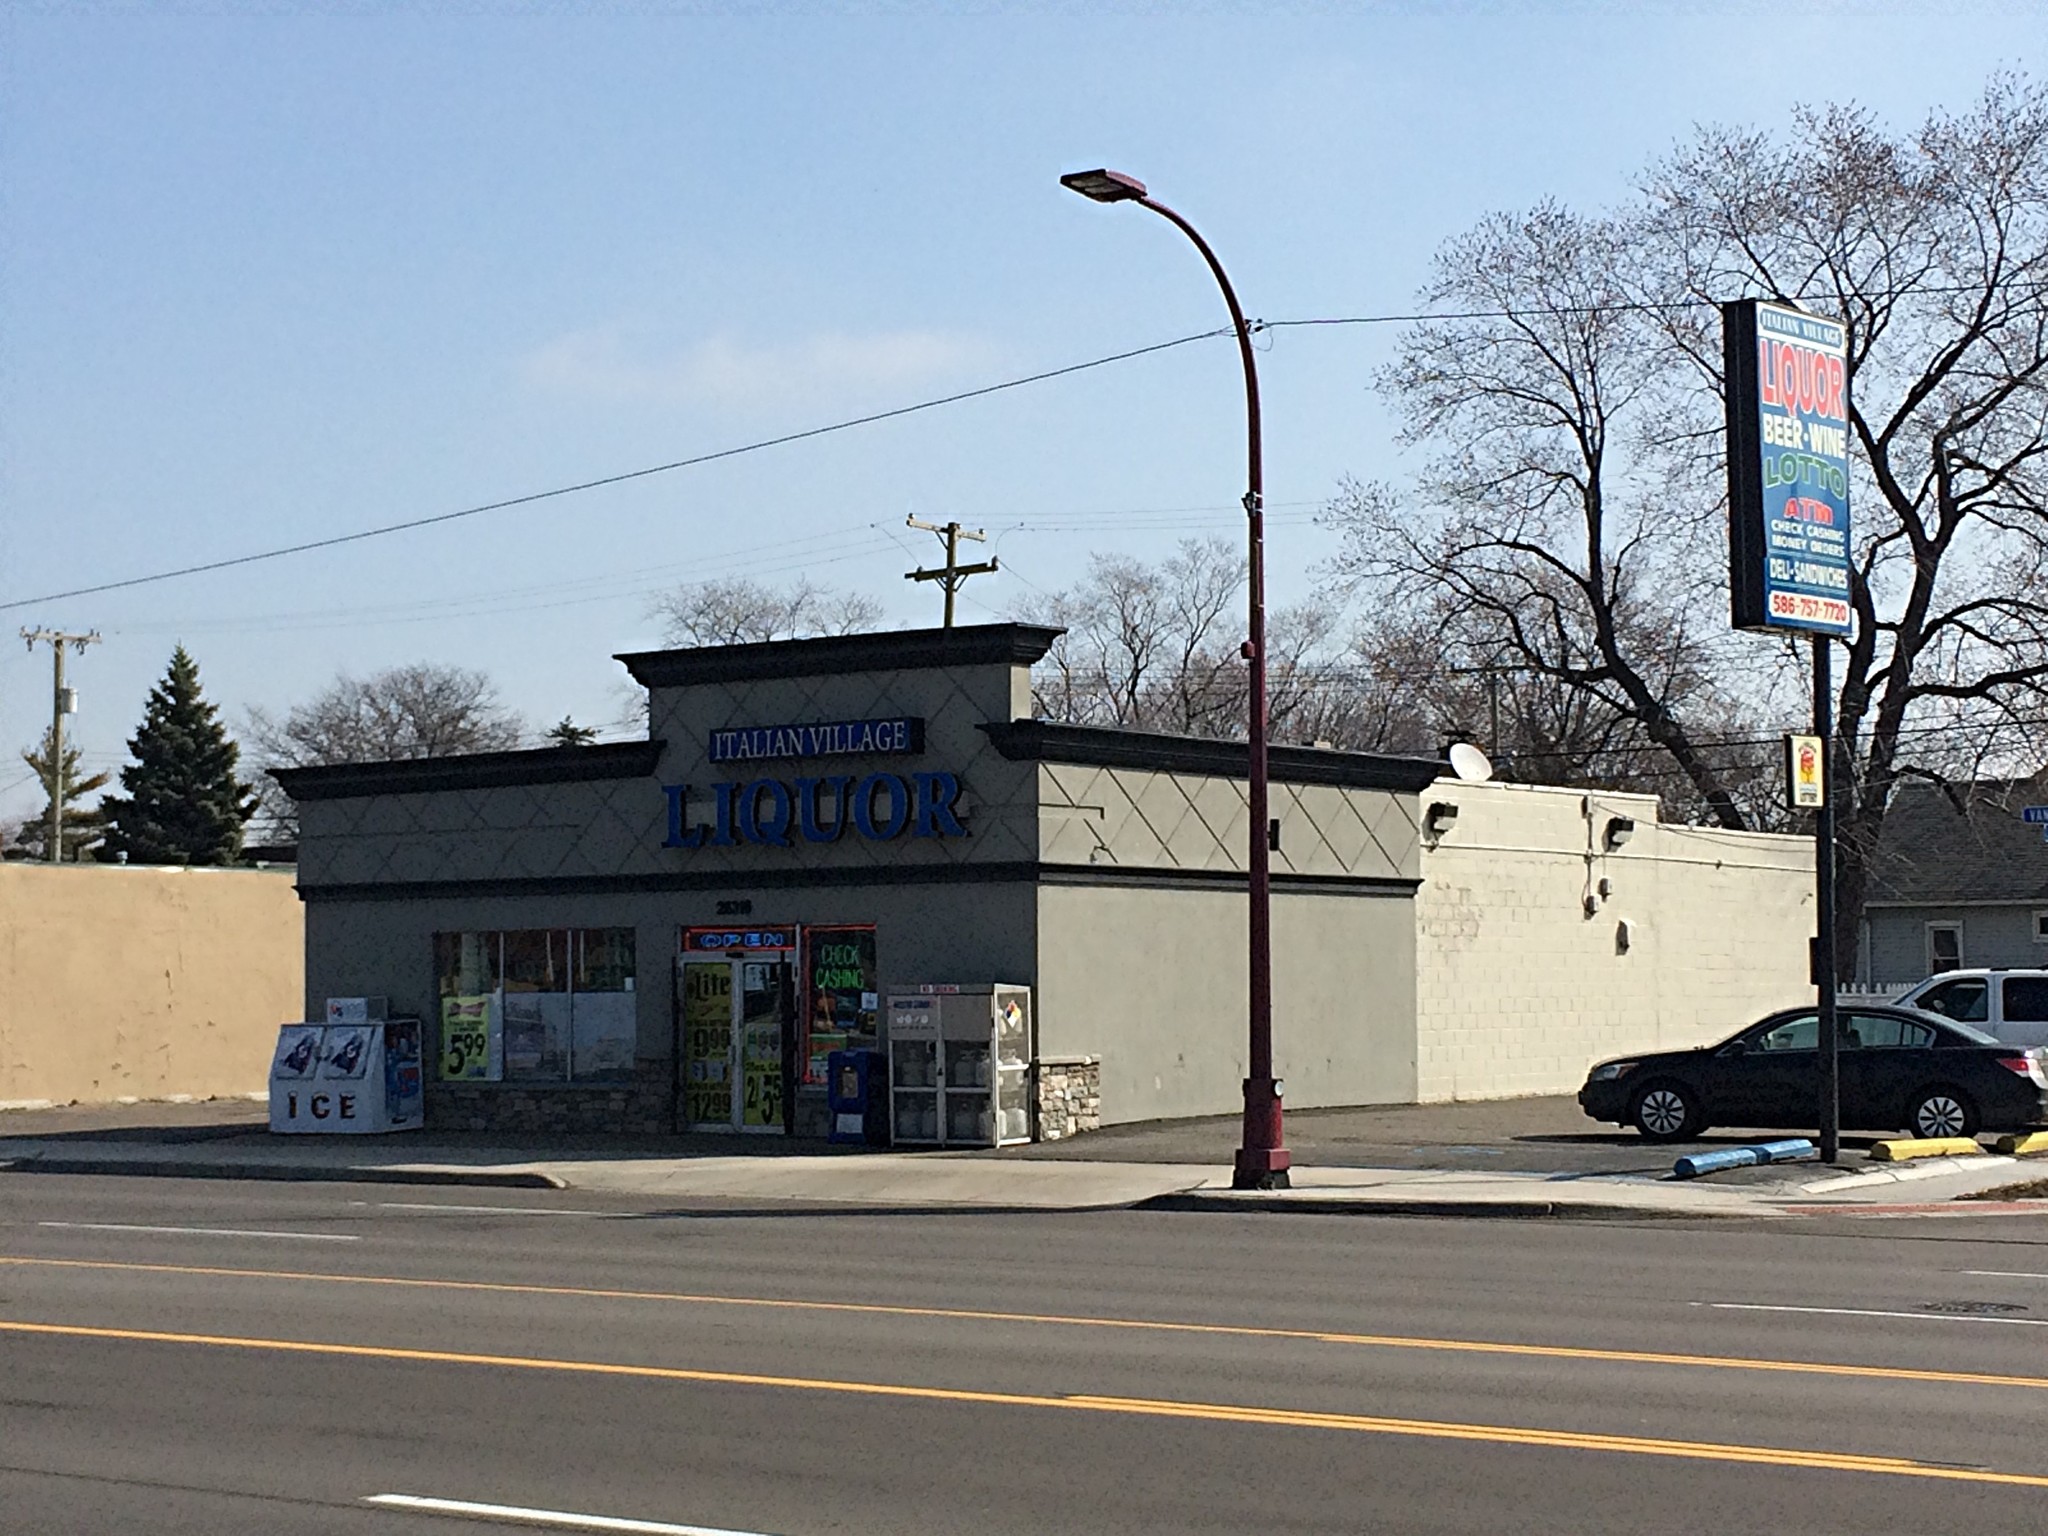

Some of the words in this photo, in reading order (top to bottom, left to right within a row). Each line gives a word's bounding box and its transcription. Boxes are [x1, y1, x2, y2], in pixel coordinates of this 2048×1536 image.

[1762, 312, 1799, 334] ITALIAN
[1802, 322, 1841, 346] VILLAGE
[1760, 338, 1845, 422] LIQUOR
[1765, 452, 1846, 500] LOTTO
[1784, 497, 1833, 526] ATM
[1771, 519, 1804, 536] CHECK
[1806, 524, 1845, 543] CASHING
[1771, 534, 1807, 550] MONEY
[1810, 540, 1845, 558] ORDERS
[714, 728, 804, 760] ITALIAN
[809, 721, 906, 756] VILLAGE
[661, 771, 969, 849] LIQUOR
[699, 932, 784, 948] OPEN
[821, 944, 860, 966] CHECK
[694, 971, 731, 1002] Lite
[815, 968, 864, 990] CASHING
[288, 1091, 356, 1120] ICE
